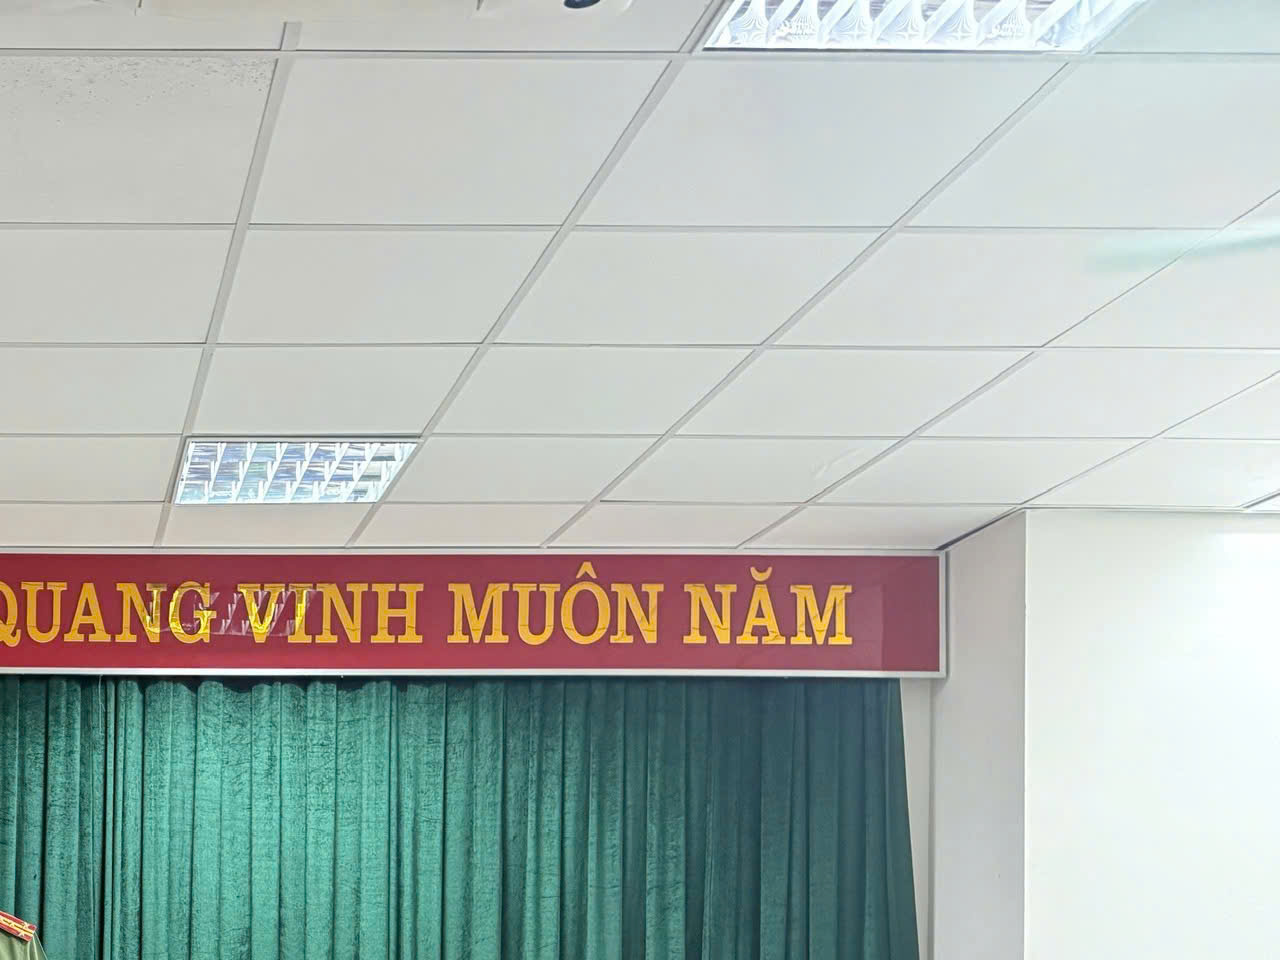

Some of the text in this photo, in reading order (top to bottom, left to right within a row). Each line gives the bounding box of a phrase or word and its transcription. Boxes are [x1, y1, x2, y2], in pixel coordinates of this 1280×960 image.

[236, 582, 425, 645] VINH
[447, 561, 665, 646] MUÔN
[682, 568, 854, 646] NĂM
